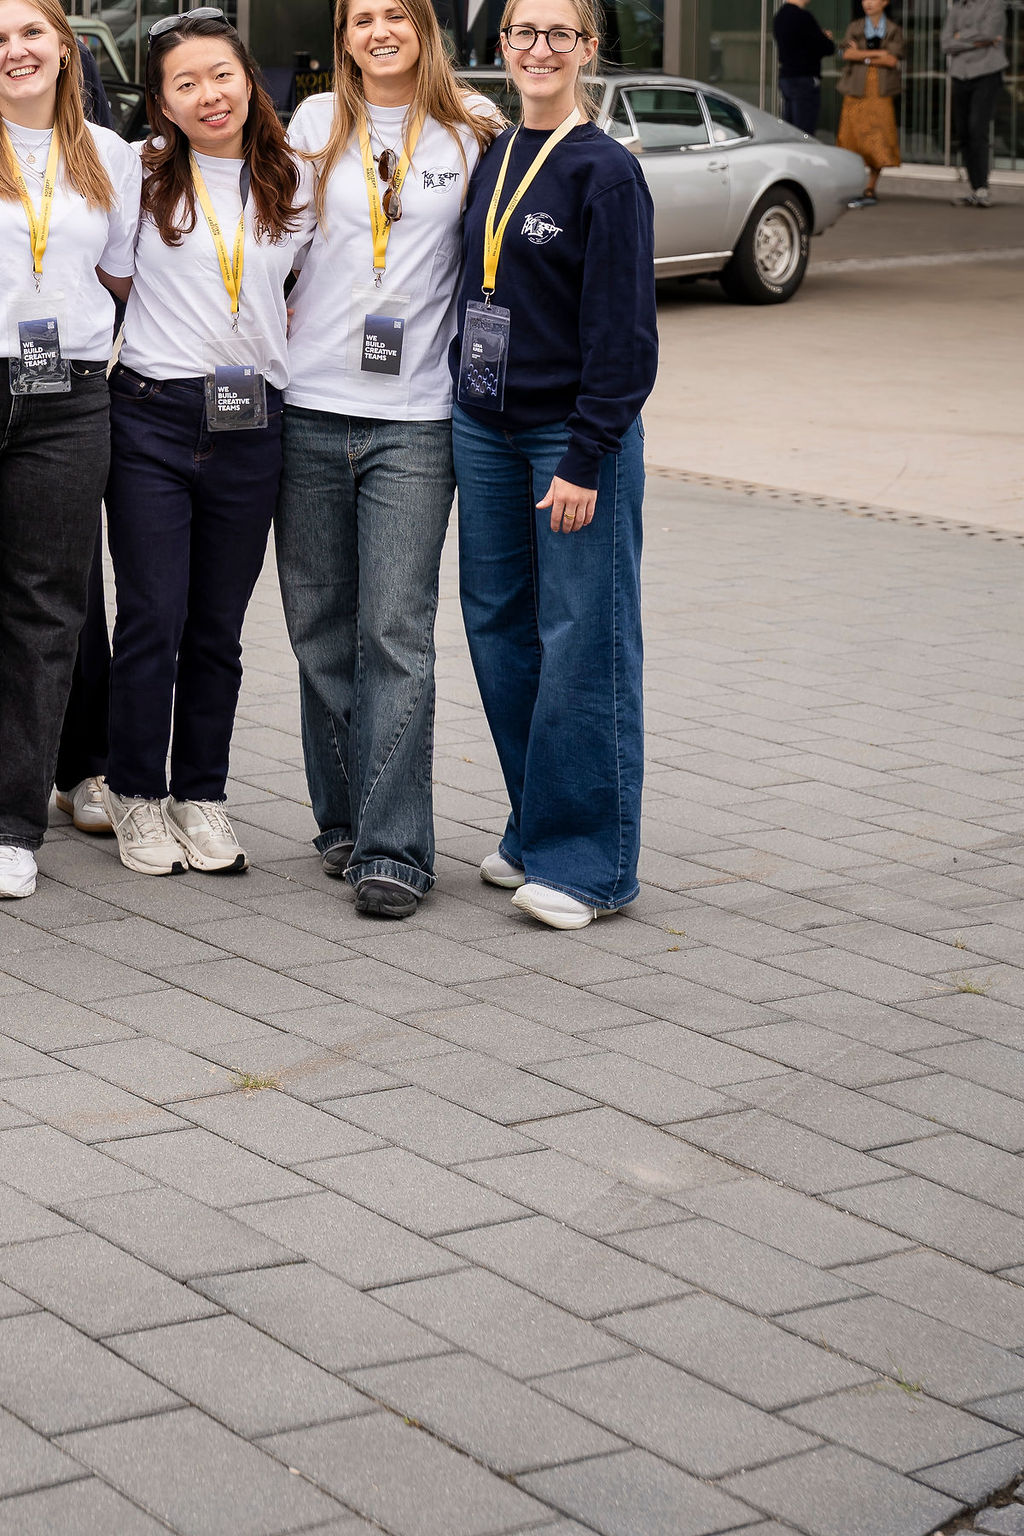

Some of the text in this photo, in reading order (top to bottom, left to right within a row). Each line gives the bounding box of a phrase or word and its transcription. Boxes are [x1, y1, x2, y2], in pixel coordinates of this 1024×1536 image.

[421, 170, 460, 182] KOZEPT
[423, 178, 446, 189] HAS
[365, 347, 397, 356] CREATIVE
[24, 352, 56, 361] CREATIVE
[364, 353, 387, 361] TEAMS
[24, 359, 47, 367] TEAMS
